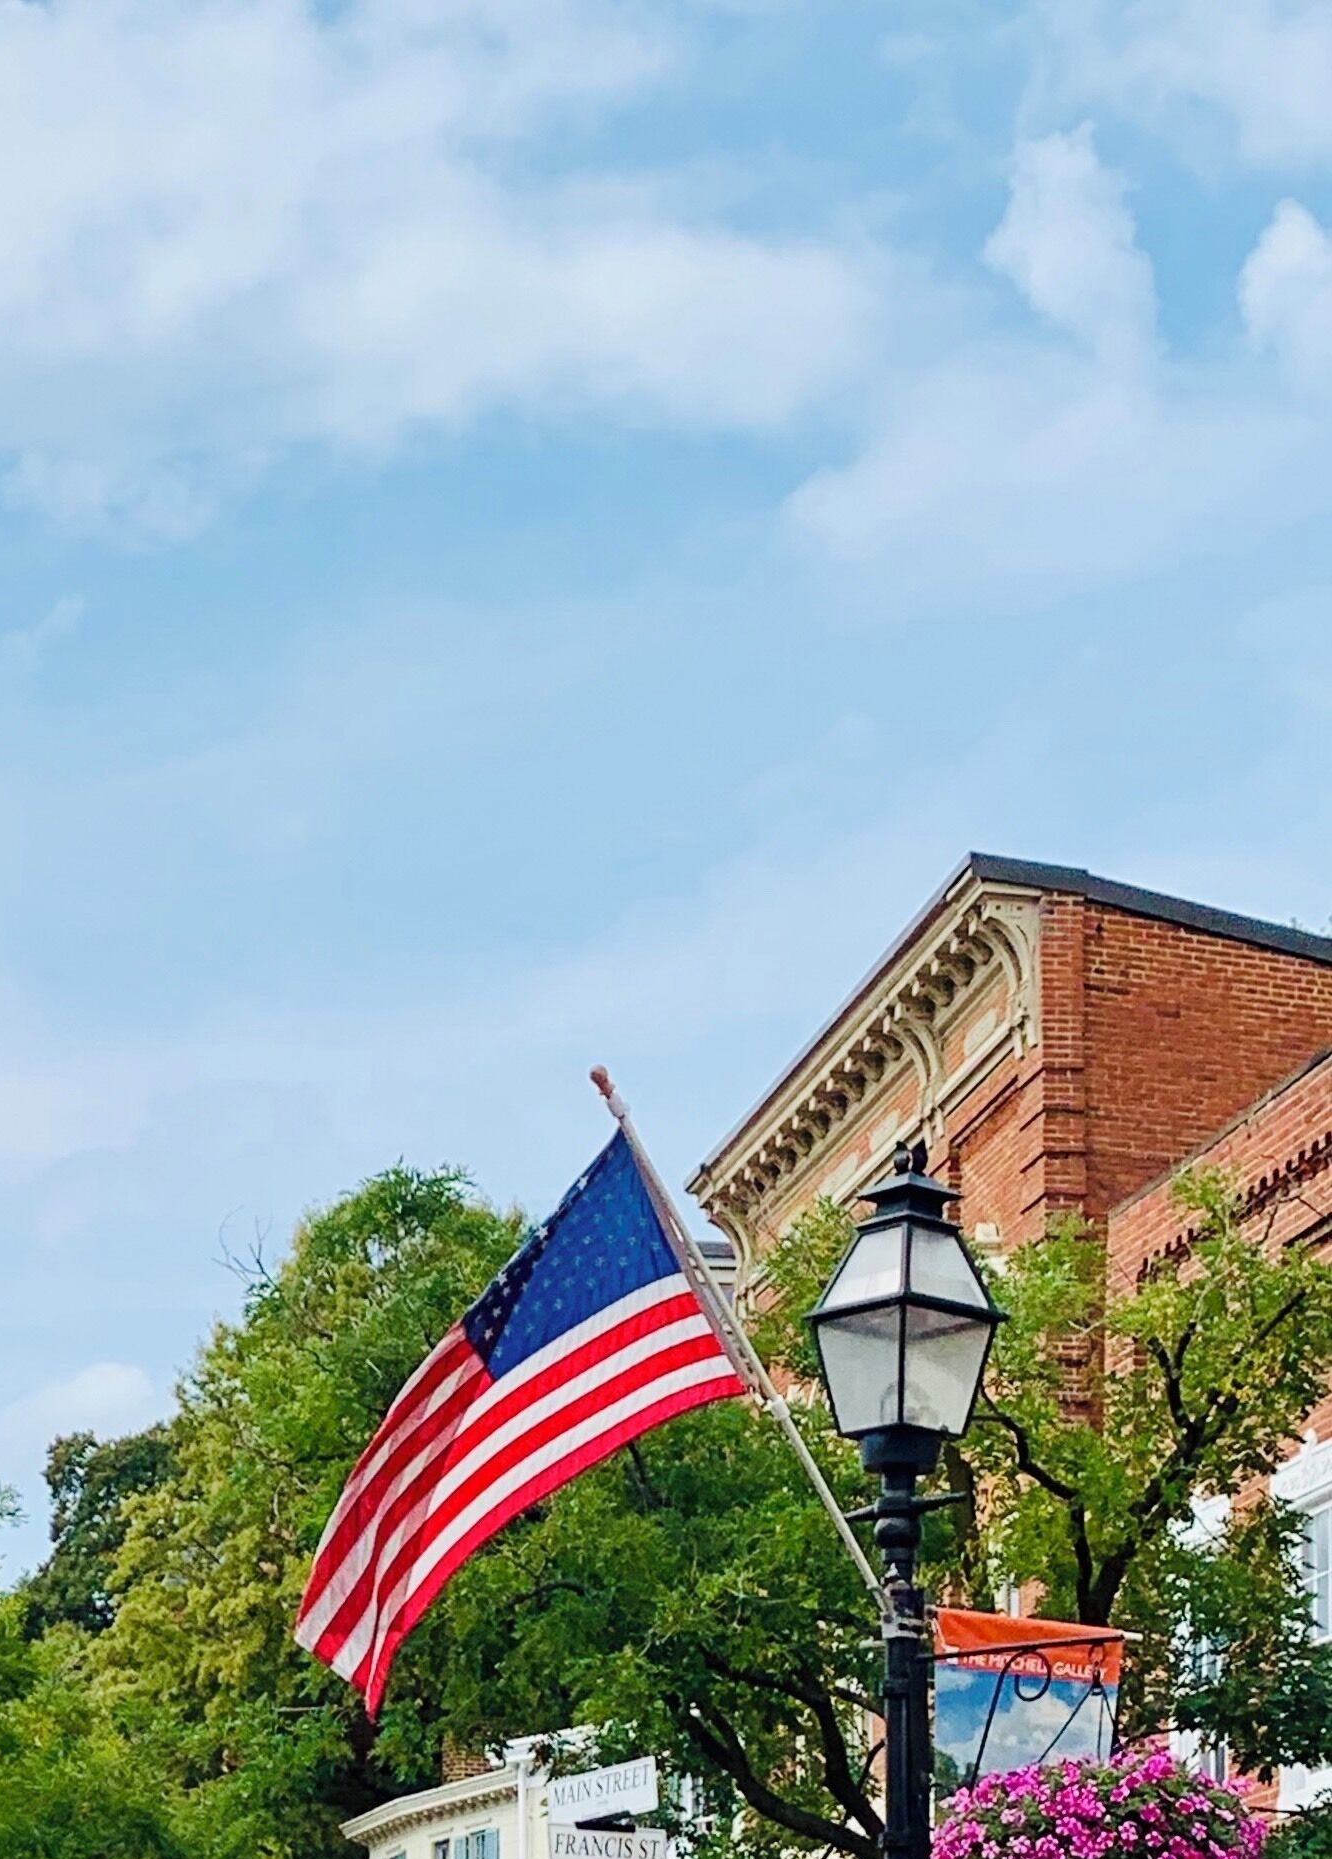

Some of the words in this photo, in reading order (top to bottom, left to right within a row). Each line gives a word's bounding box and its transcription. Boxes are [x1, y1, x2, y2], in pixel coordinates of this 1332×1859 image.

[1053, 1662, 1108, 1679] GALLEY
[553, 1781, 591, 1806] MAIN
[596, 1764, 650, 1797] STREET
[555, 1833, 633, 1859] FRANCIS
